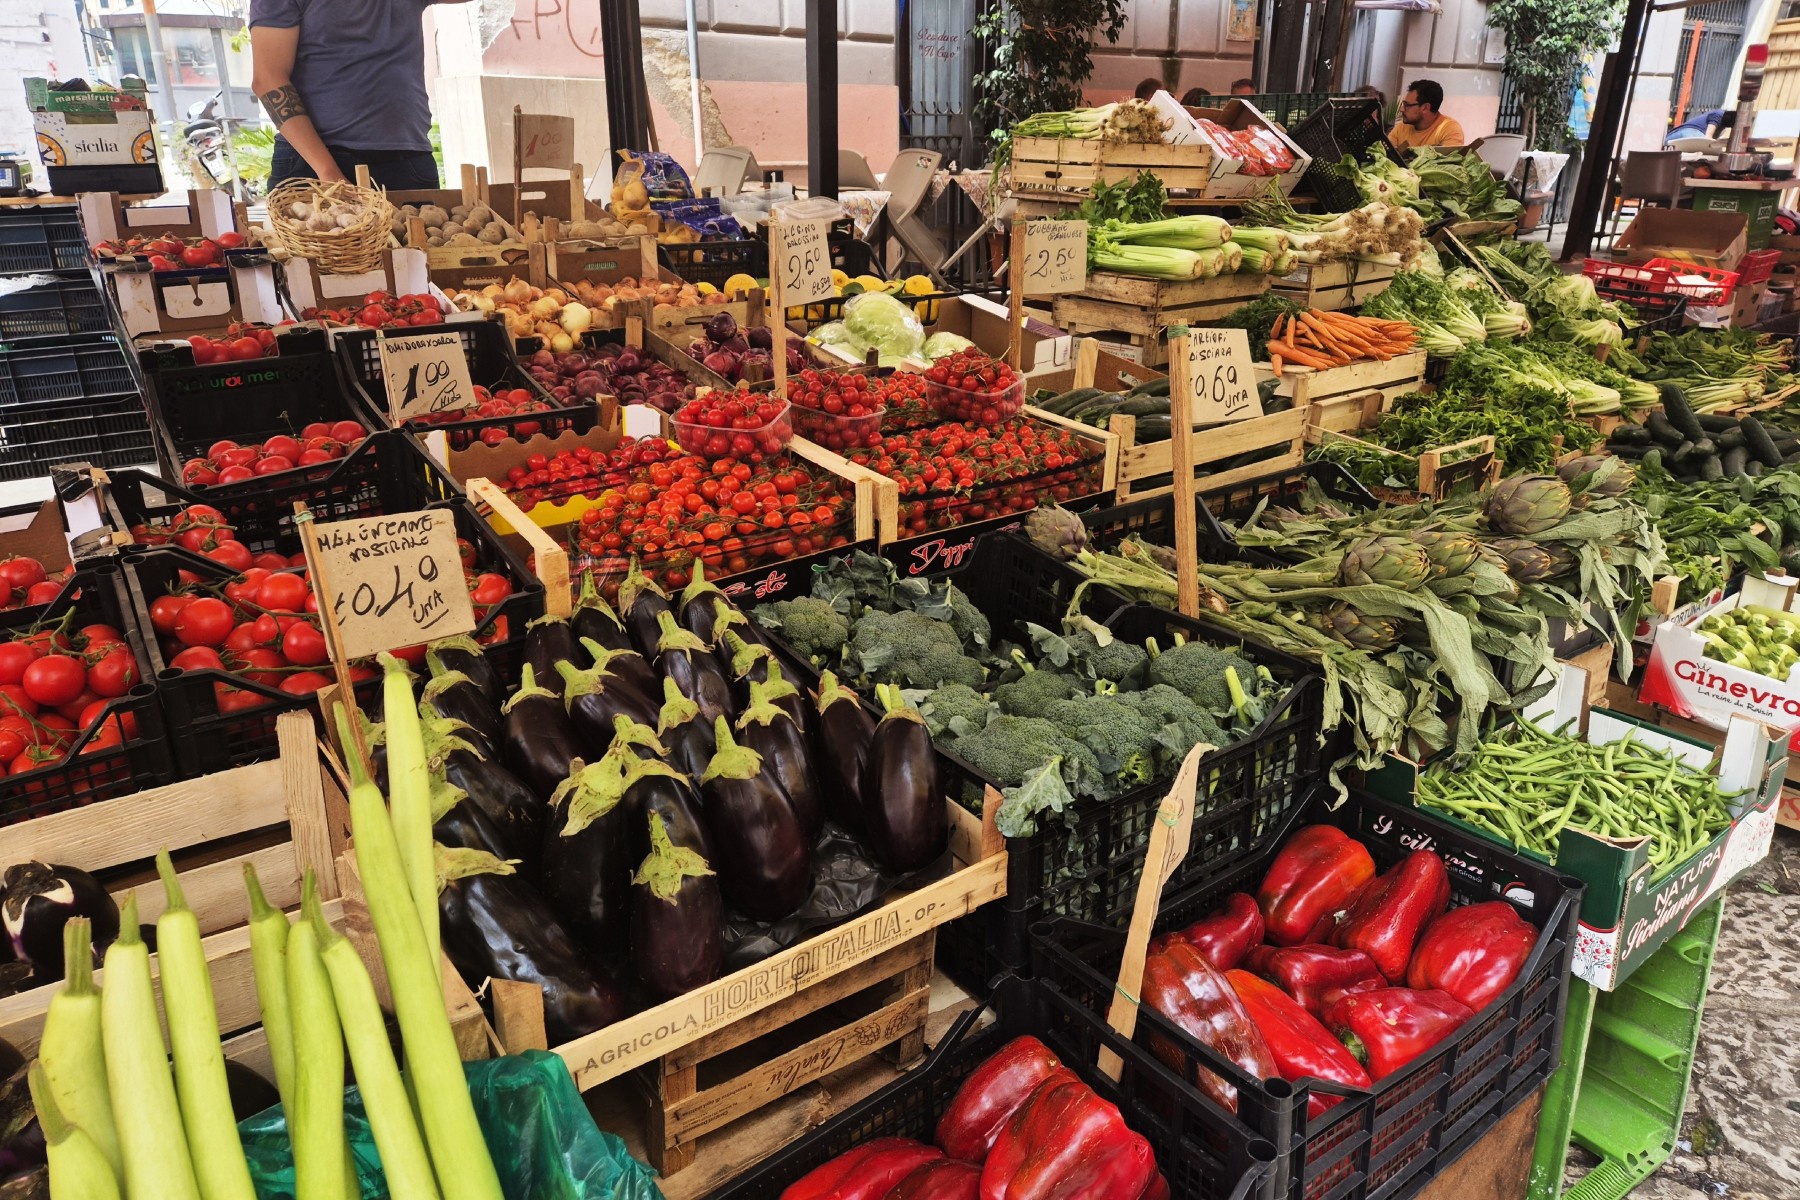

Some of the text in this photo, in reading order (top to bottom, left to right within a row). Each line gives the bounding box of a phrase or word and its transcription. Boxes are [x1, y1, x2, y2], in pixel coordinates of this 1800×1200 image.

[55, 93, 120, 103] marsalfrutta
[74, 138, 119, 153] sicilia
[948, 160, 957, 171] 4
[1225, 389, 1248, 409] UNA
[909, 537, 974, 574] Doppi
[413, 589, 444, 624] UNA
[1698, 687, 1773, 718] La reine du Raisin
[1655, 845, 1720, 911] NATURA
[1621, 883, 1700, 961] Siciliana
[584, 1014, 698, 1074] AGRICOLA
[703, 910, 901, 1023] HORTOITALIA
[914, 902, 936, 921] OP
